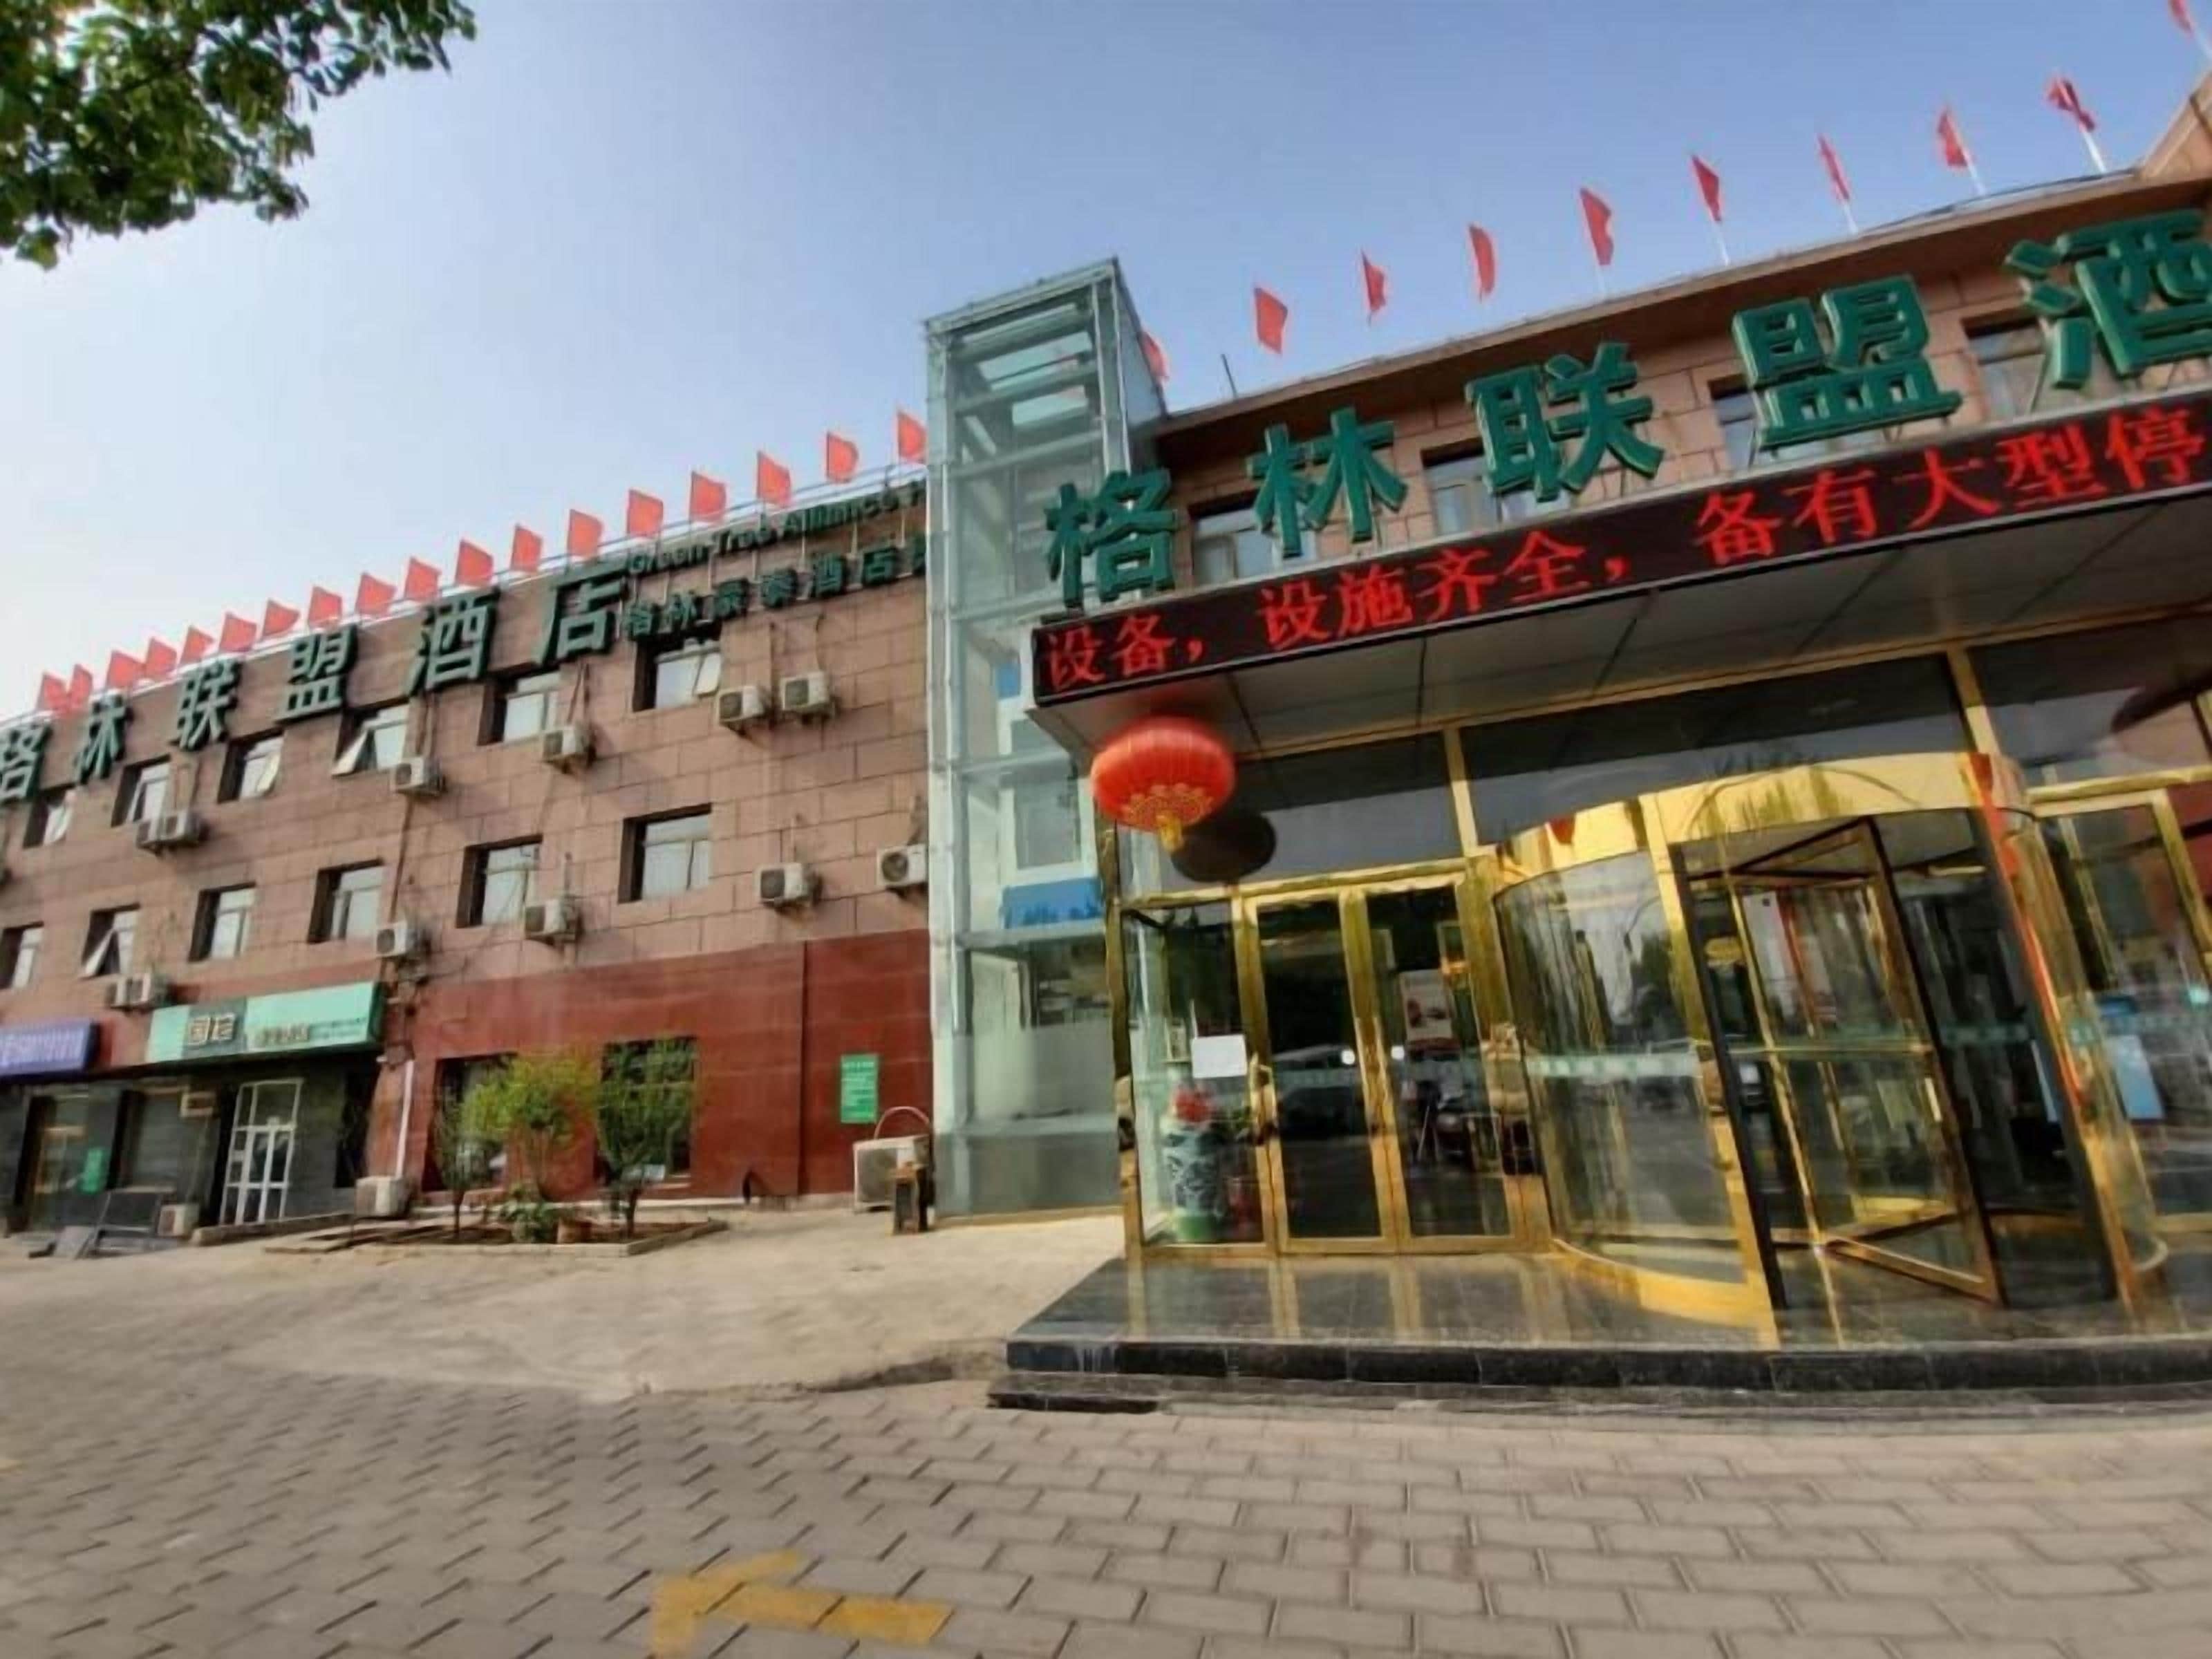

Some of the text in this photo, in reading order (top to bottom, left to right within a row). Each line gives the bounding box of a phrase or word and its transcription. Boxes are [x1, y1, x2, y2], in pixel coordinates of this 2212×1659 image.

[1043, 209, 2212, 611] 格林联盟酒
[1692, 406, 2206, 567] 备有大型停
[0, 553, 629, 805] 格林联盟酒店
